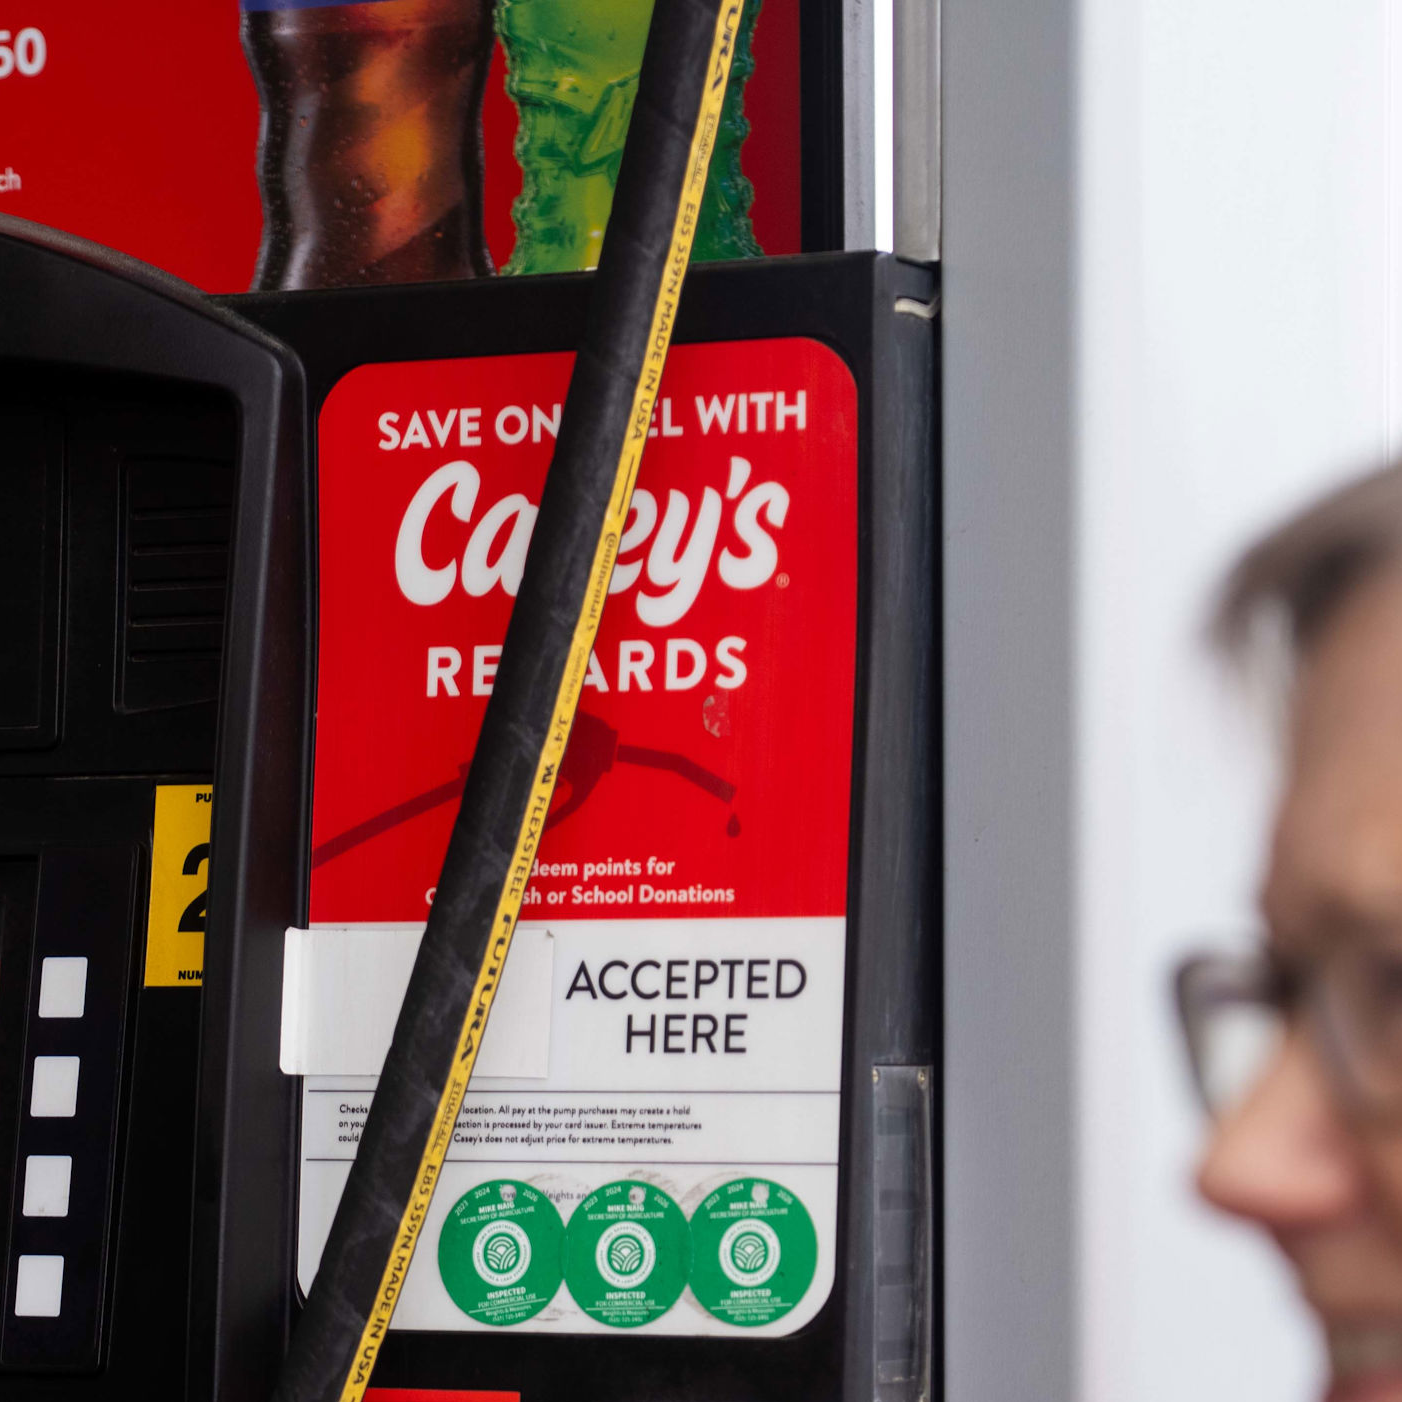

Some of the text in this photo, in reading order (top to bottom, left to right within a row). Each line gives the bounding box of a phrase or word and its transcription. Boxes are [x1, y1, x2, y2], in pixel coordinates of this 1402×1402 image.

[377, 391, 807, 451] SAVE ON WITH
[395, 456, 790, 628] Caey's
[426, 636, 748, 697] REARDS
[509, 795, 548, 900] FLEXSTEEL
[583, 857, 676, 883] points for
[546, 888, 566, 903] or
[571, 884, 629, 904] School
[638, 884, 736, 903] Donations
[460, 912, 512, 1062] FUTURA
[567, 958, 807, 1001] ACCEPTED
[626, 1012, 748, 1054] HERE
[454, 1134, 673, 1145] Casey's does not adjust price for extreme temperatures.
[479, 1205, 496, 1213] MIKE
[353, 1164, 436, 1385] E85 MADE IN USA
[487, 1287, 526, 1298] INSPECTED
